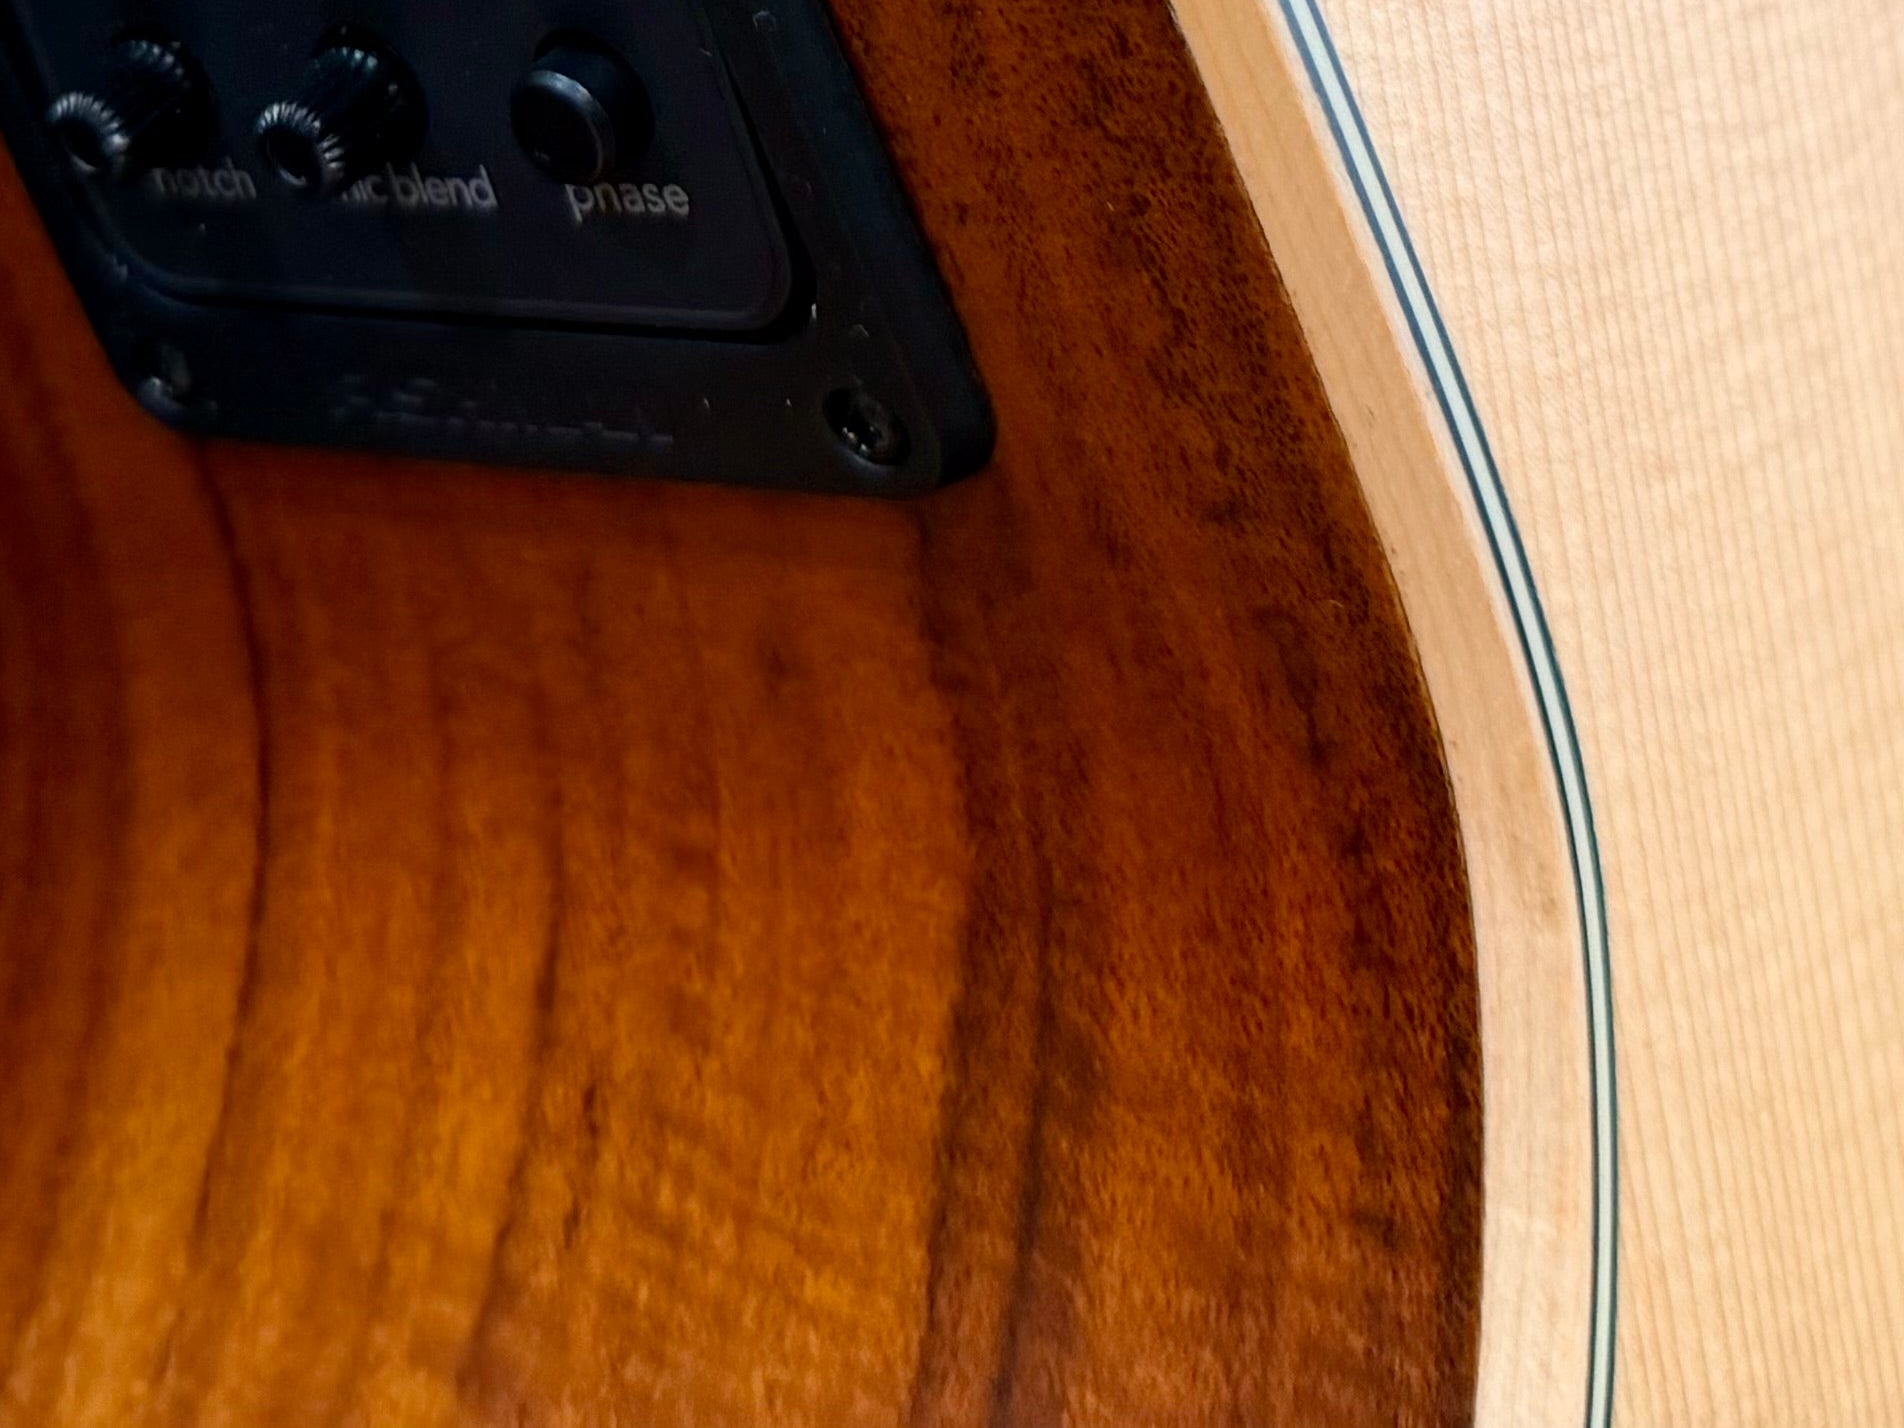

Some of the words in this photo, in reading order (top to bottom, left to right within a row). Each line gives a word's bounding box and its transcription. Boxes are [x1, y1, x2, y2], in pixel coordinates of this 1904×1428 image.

[150, 156, 257, 200] notch
[387, 161, 497, 209] blend
[565, 181, 690, 224] phase
